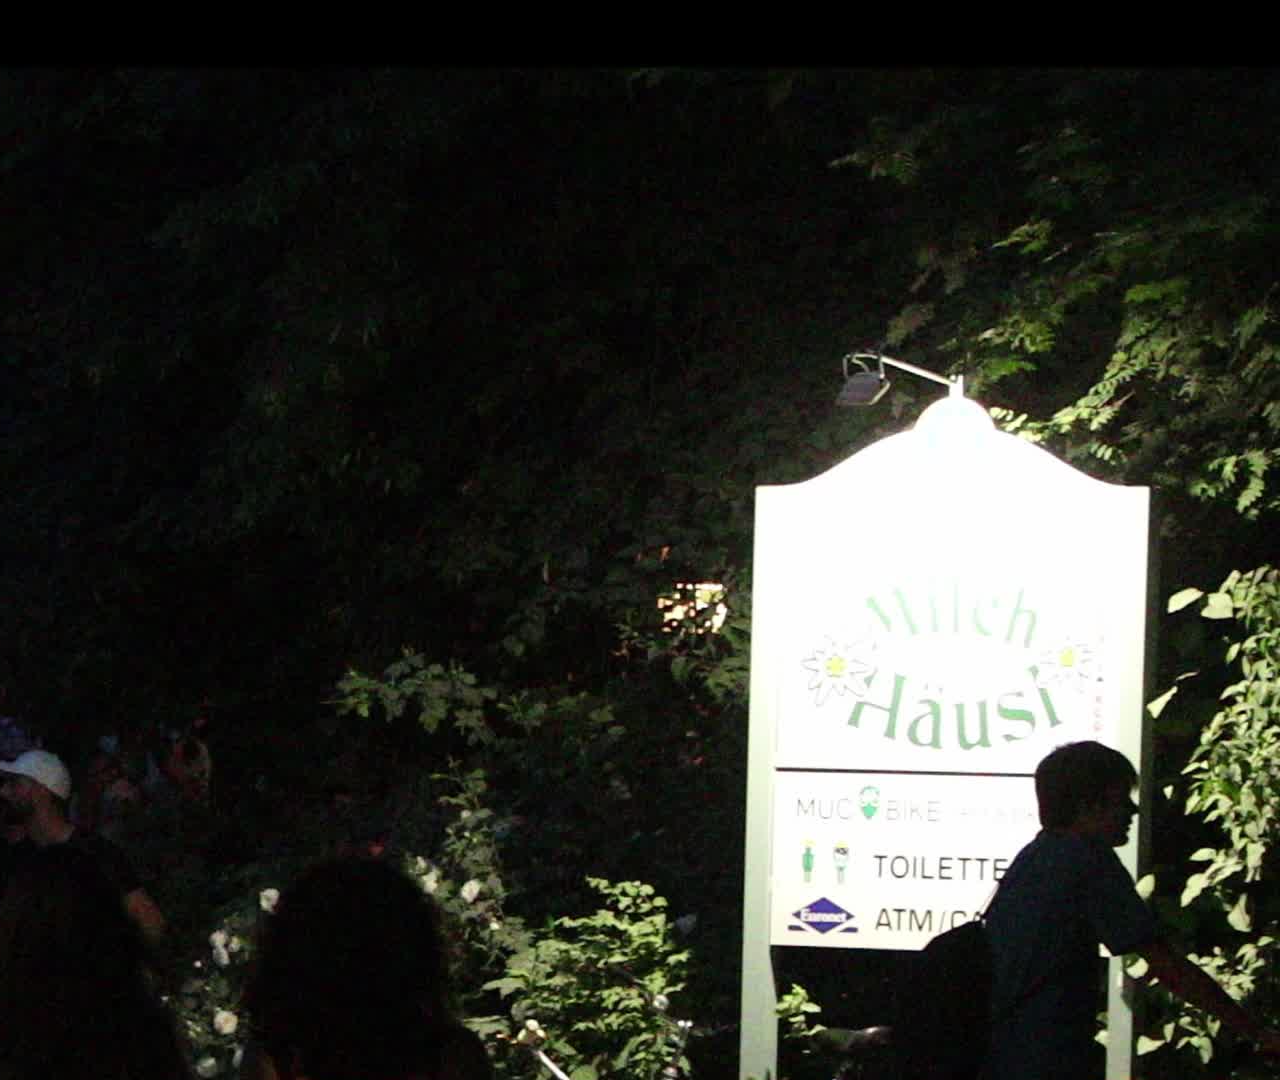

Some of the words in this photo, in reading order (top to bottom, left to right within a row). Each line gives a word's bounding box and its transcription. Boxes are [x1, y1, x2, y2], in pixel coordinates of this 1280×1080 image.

[865, 574, 1038, 649] Milch
[796, 798, 852, 821] MUC
[887, 799, 941, 822] BIKE
